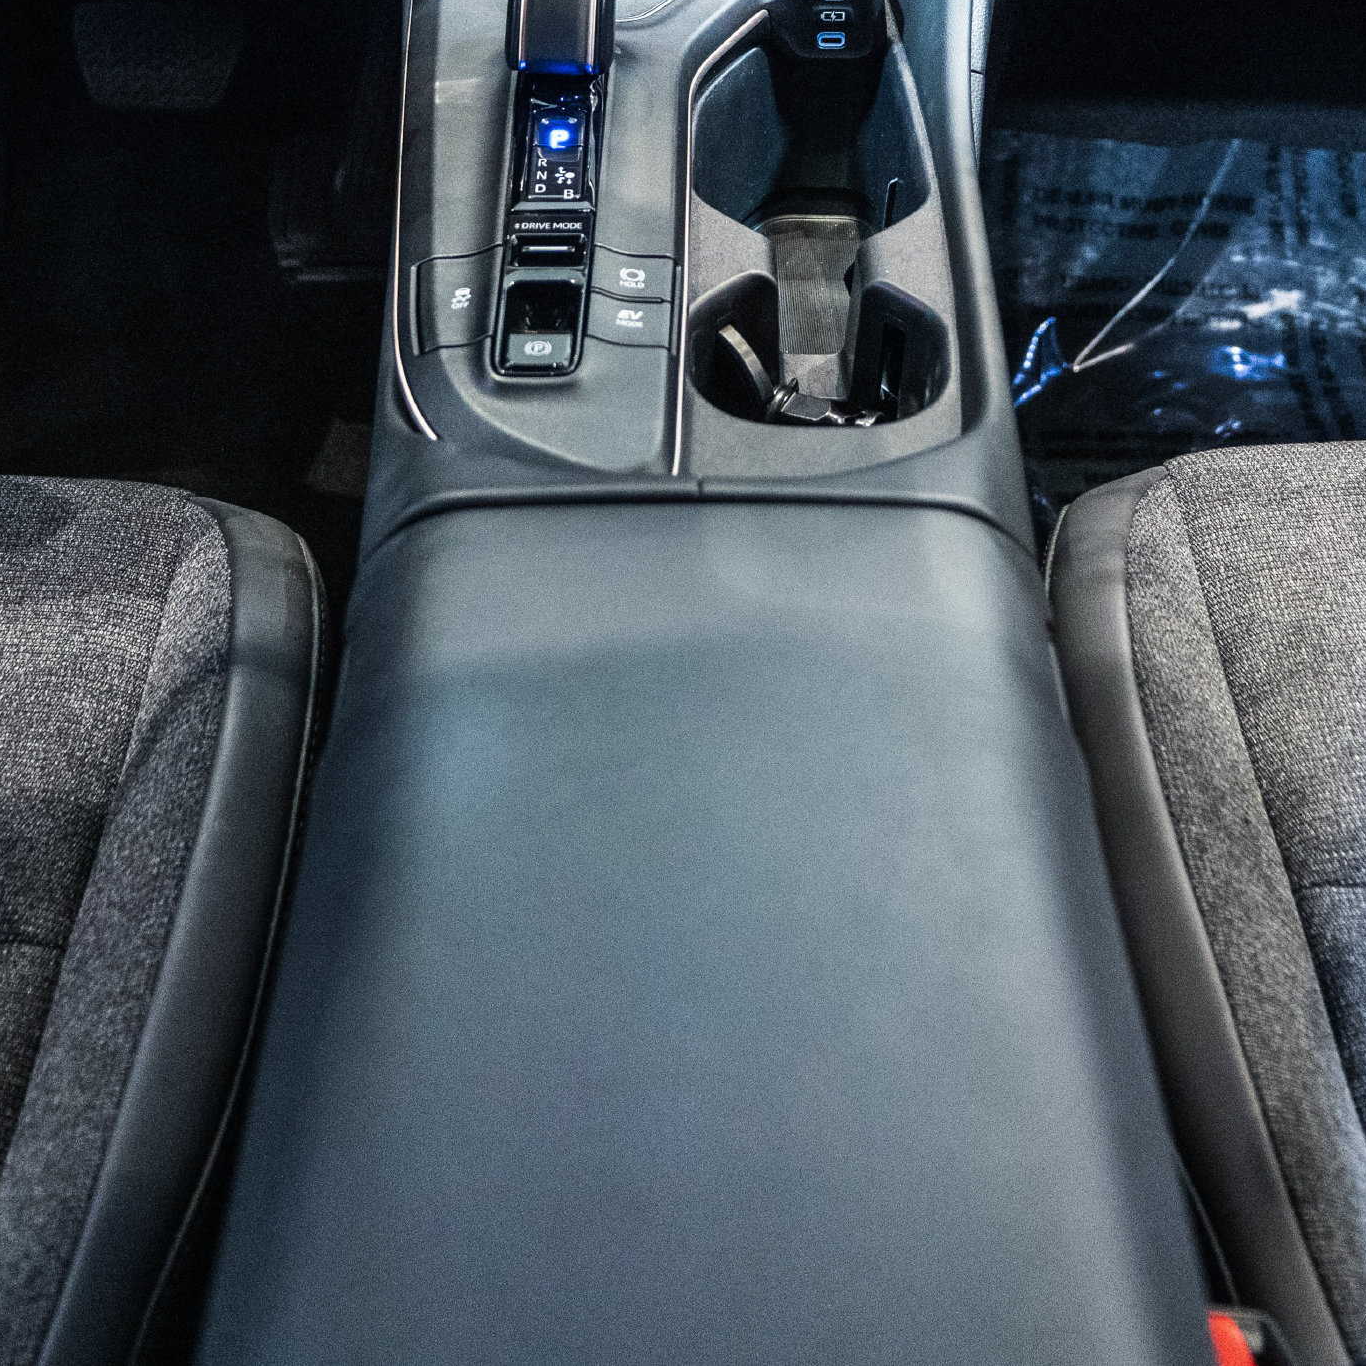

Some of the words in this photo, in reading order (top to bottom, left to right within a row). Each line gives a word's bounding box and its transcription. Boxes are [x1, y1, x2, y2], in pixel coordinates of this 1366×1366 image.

[549, 129, 570, 149] P
[537, 159, 547, 167] R
[536, 171, 548, 180] N
[535, 184, 546, 193] D
[563, 189, 574, 199] B
[521, 222, 552, 230] DRIVE
[552, 222, 583, 230] MODE
[619, 280, 645, 288] HOLD
[451, 301, 469, 310] OFF
[616, 309, 643, 320] EV
[615, 320, 643, 328] MODE
